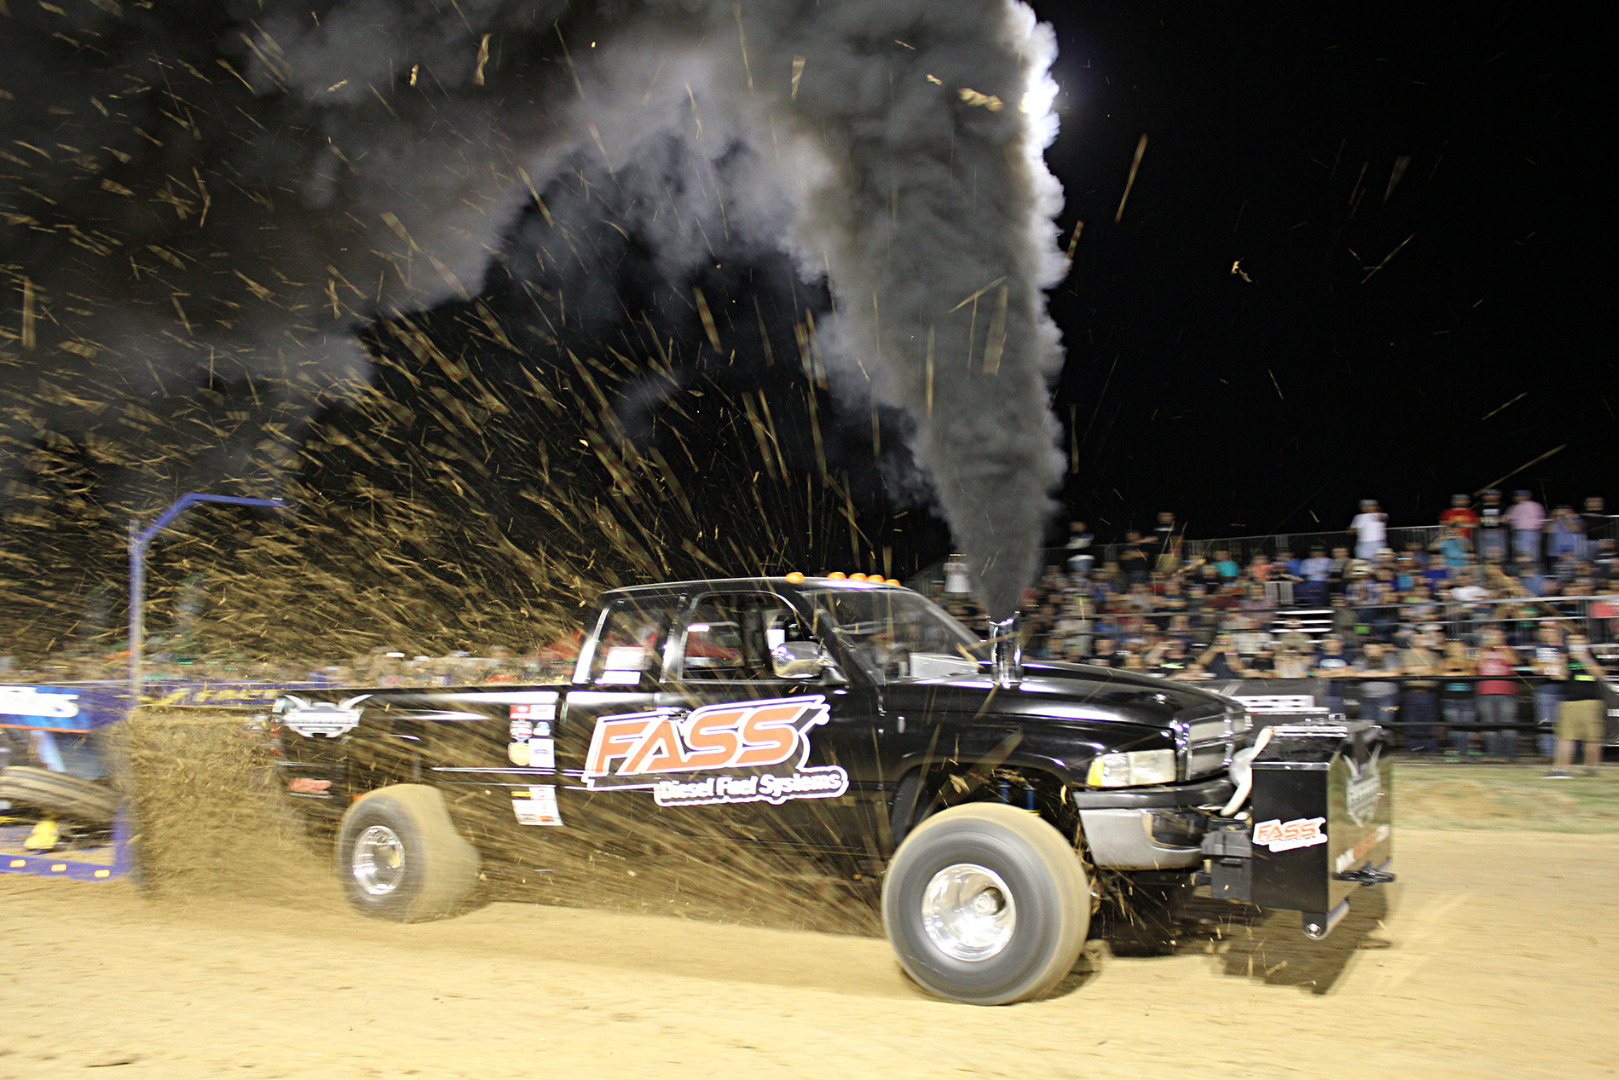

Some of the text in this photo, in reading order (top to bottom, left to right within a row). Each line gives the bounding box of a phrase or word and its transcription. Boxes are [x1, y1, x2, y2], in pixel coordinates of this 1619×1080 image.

[592, 702, 814, 777] FASS
[659, 773, 842, 799] Diesel Fuel Systems
[1257, 822, 1318, 841] FASS
